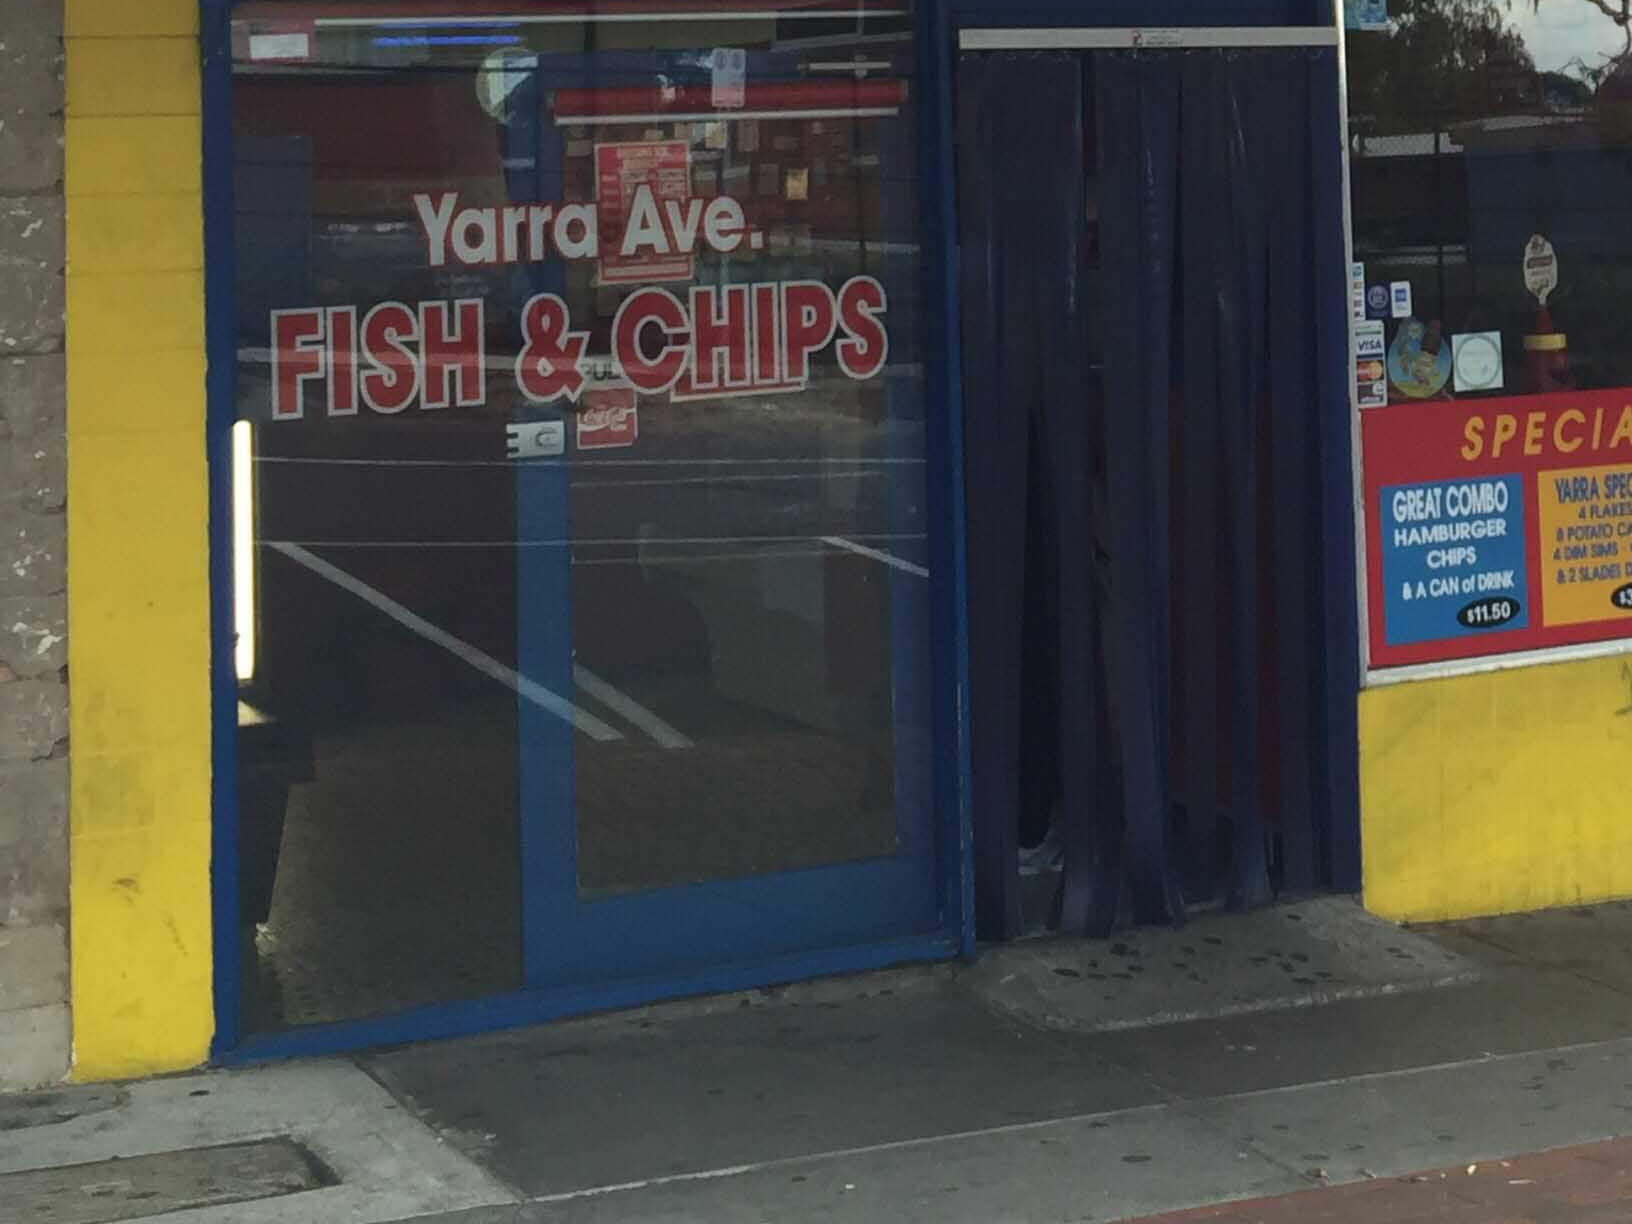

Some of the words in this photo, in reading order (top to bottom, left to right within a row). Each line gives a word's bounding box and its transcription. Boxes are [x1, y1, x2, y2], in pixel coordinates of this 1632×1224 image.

[412, 191, 598, 268] Yarra
[620, 183, 766, 258] Ave.
[270, 298, 486, 421] FISH
[515, 292, 591, 403] &
[612, 275, 888, 396] CHIPS
[1358, 337, 1382, 351] VISA
[1393, 488, 1442, 523] GREAT
[1446, 480, 1508, 517] COMBO
[1555, 476, 1601, 504] YARRA
[1578, 505, 1586, 519] 4
[1590, 502, 1632, 519] FLAKES
[1394, 518, 1506, 547] HAMBURGER
[1567, 523, 1614, 541] POTATO
[1427, 545, 1476, 568] CHIPS
[1553, 548, 1561, 560] 4
[1564, 545, 1586, 560] DIM
[1590, 542, 1618, 558] SIMS
[1402, 582, 1412, 600] &
[1416, 581, 1427, 599] A
[1429, 576, 1458, 597] CAN
[1462, 576, 1475, 593] of
[1477, 570, 1514, 592] DRINK
[1568, 567, 1577, 583] 2
[1467, 601, 1511, 623] $11.50
